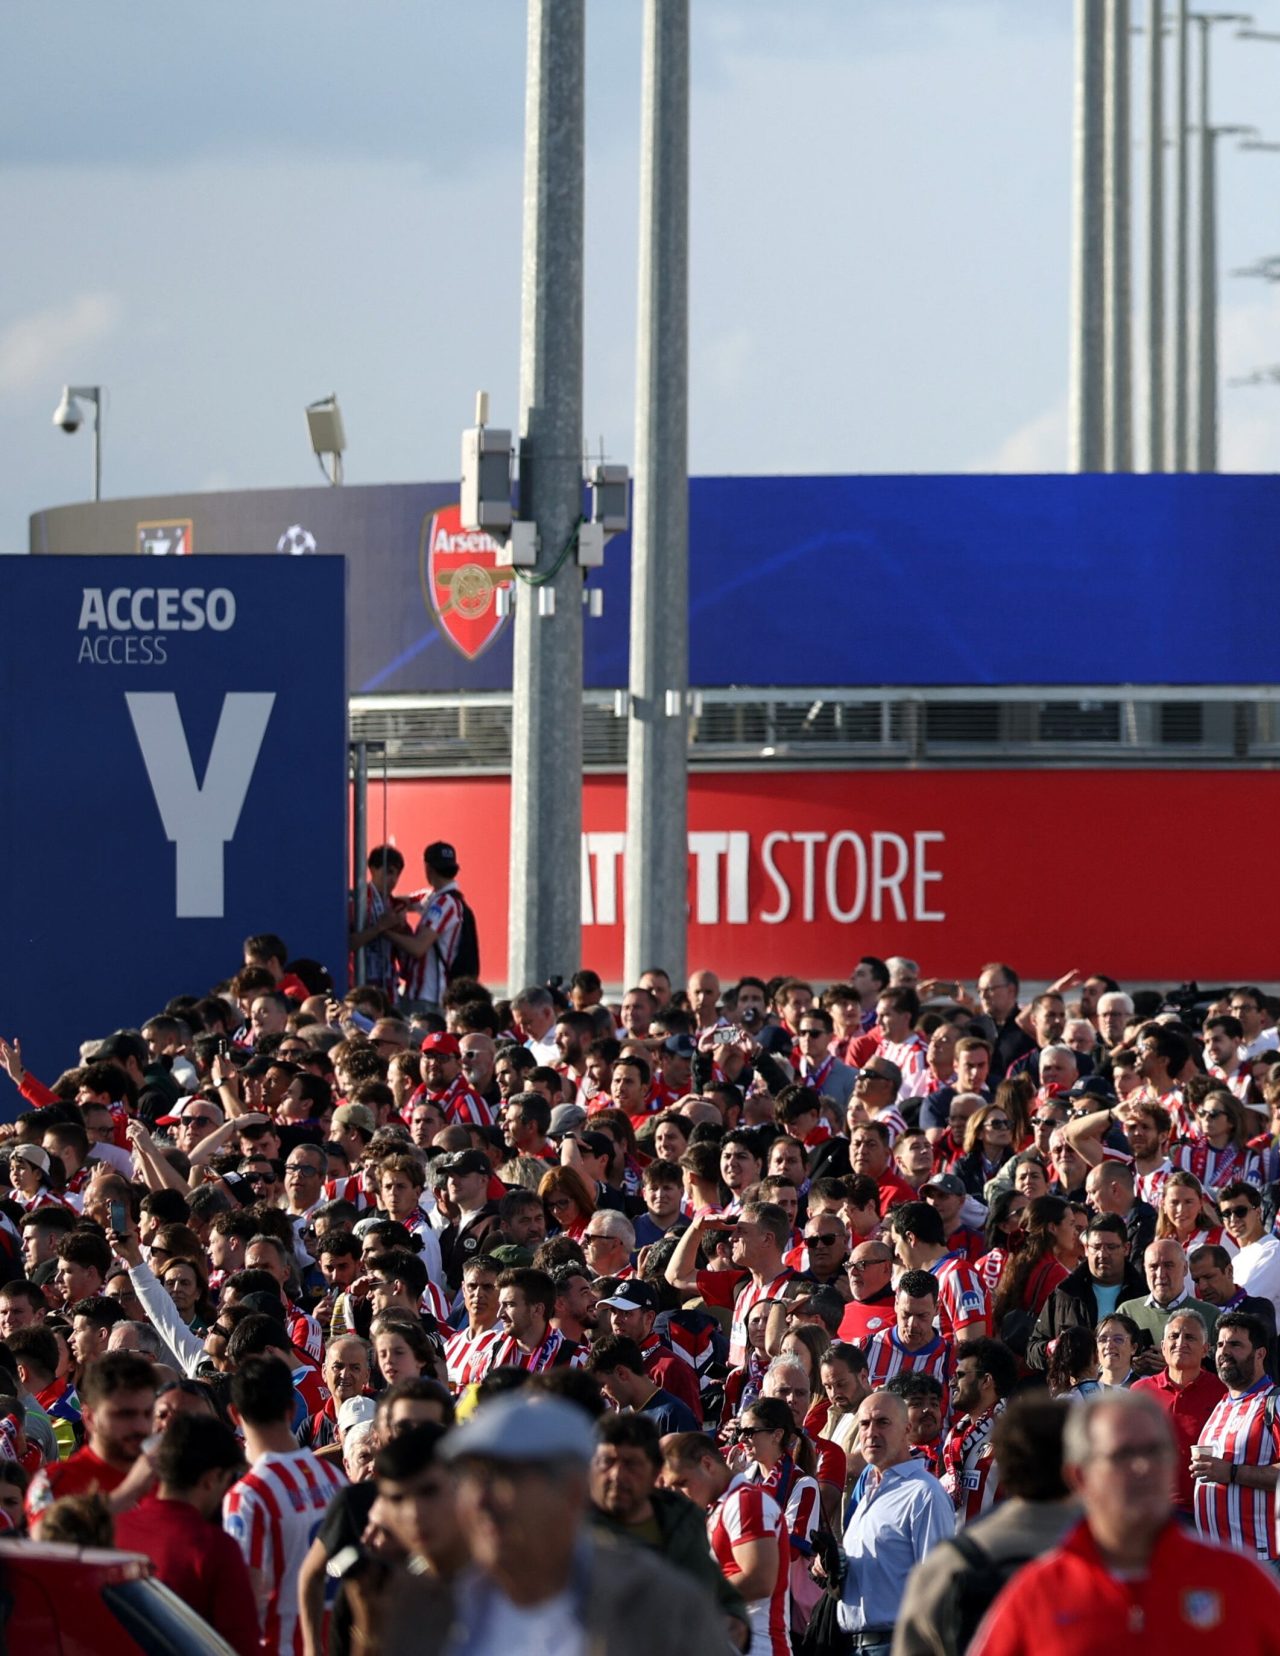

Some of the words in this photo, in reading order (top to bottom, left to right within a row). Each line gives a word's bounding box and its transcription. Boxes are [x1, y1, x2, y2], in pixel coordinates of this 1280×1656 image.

[434, 528, 497, 553] Arsen
[77, 587, 236, 631] ACCESO
[77, 635, 167, 664] ACCESS
[124, 691, 277, 917] Y
[581, 832, 749, 925] TTI
[759, 831, 946, 923] STORE
